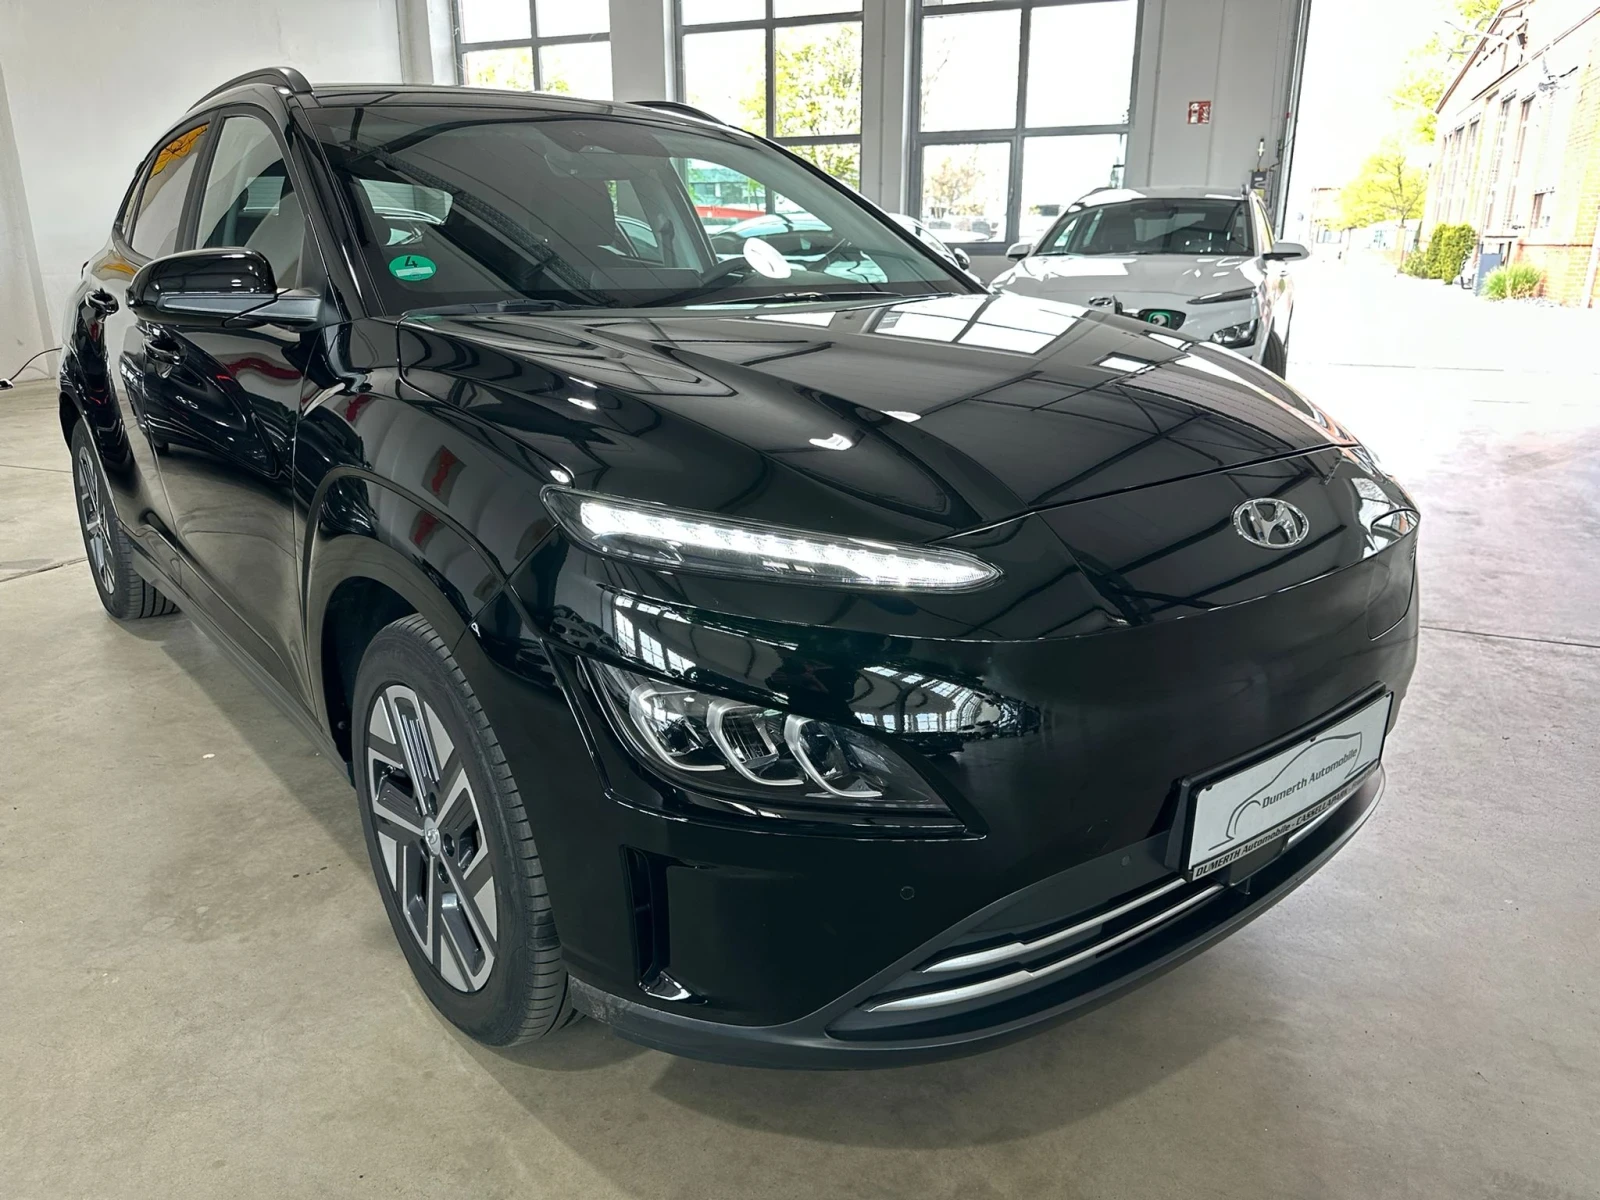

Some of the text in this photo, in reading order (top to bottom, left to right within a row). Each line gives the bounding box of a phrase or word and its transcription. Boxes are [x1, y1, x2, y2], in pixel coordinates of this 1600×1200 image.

[404, 255, 418, 268] 4
[1261, 777, 1308, 808] Dumerth
[1308, 748, 1358, 784] Automobile
[1195, 848, 1242, 877] DUMERTH
[1241, 824, 1291, 855] Automobile
